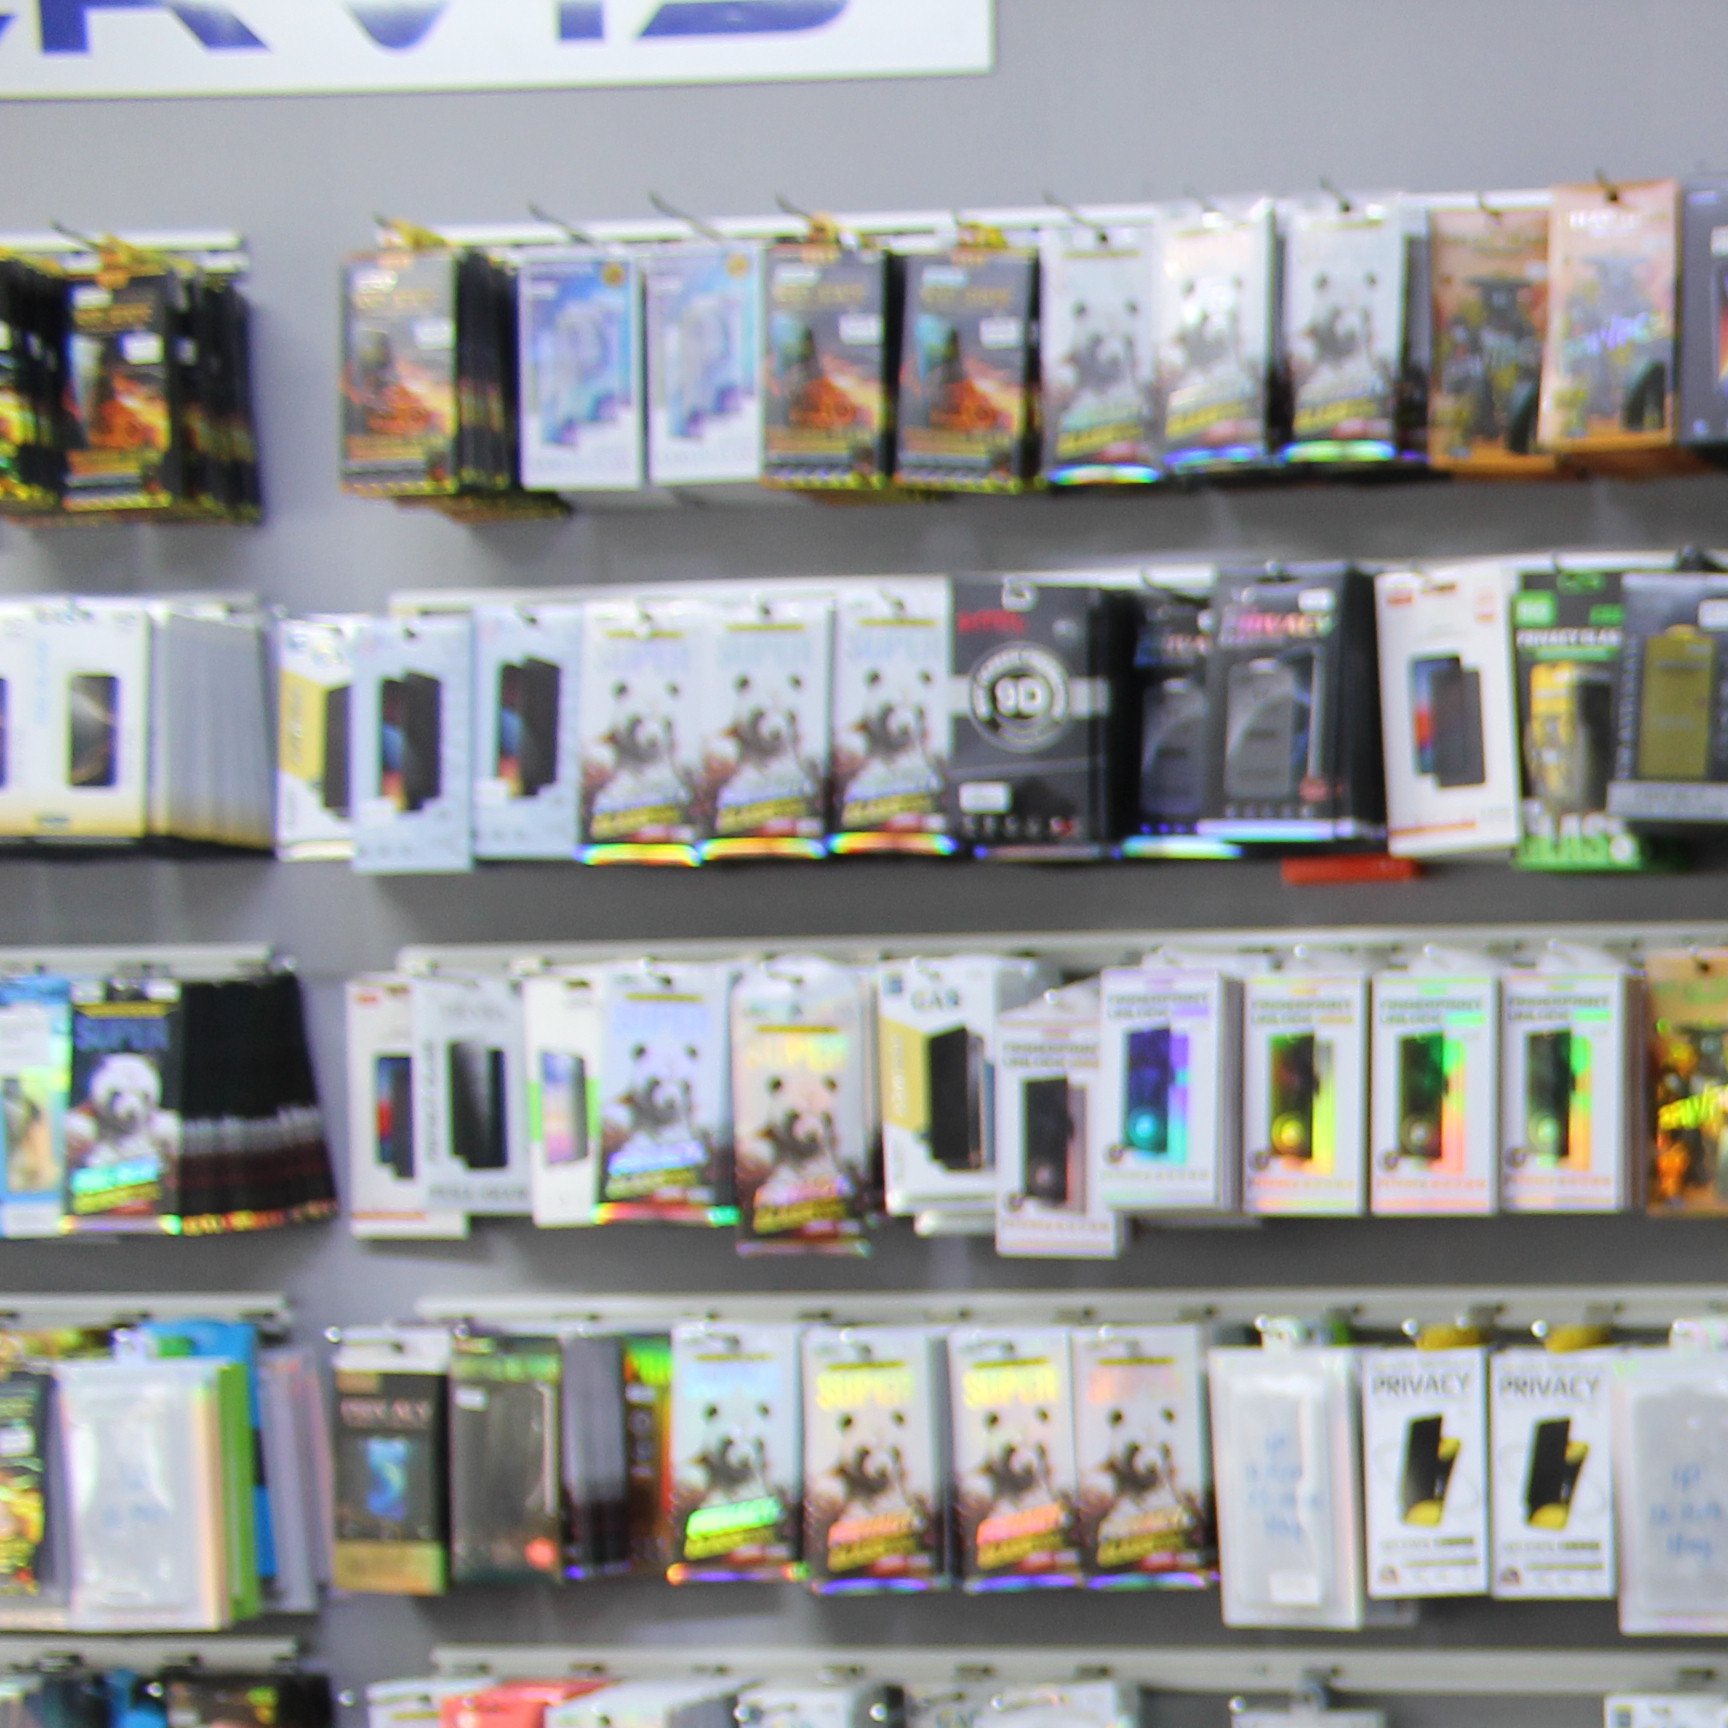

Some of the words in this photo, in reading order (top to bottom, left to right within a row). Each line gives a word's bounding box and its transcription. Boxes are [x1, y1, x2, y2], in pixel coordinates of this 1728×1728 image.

[995, 677, 1048, 718] 9D
[814, 1368, 913, 1410] SUPER
[962, 1365, 1060, 1409] SUPER
[1372, 1372, 1471, 1398] PRIVACY
[1499, 1374, 1600, 1401] PRIVACY
